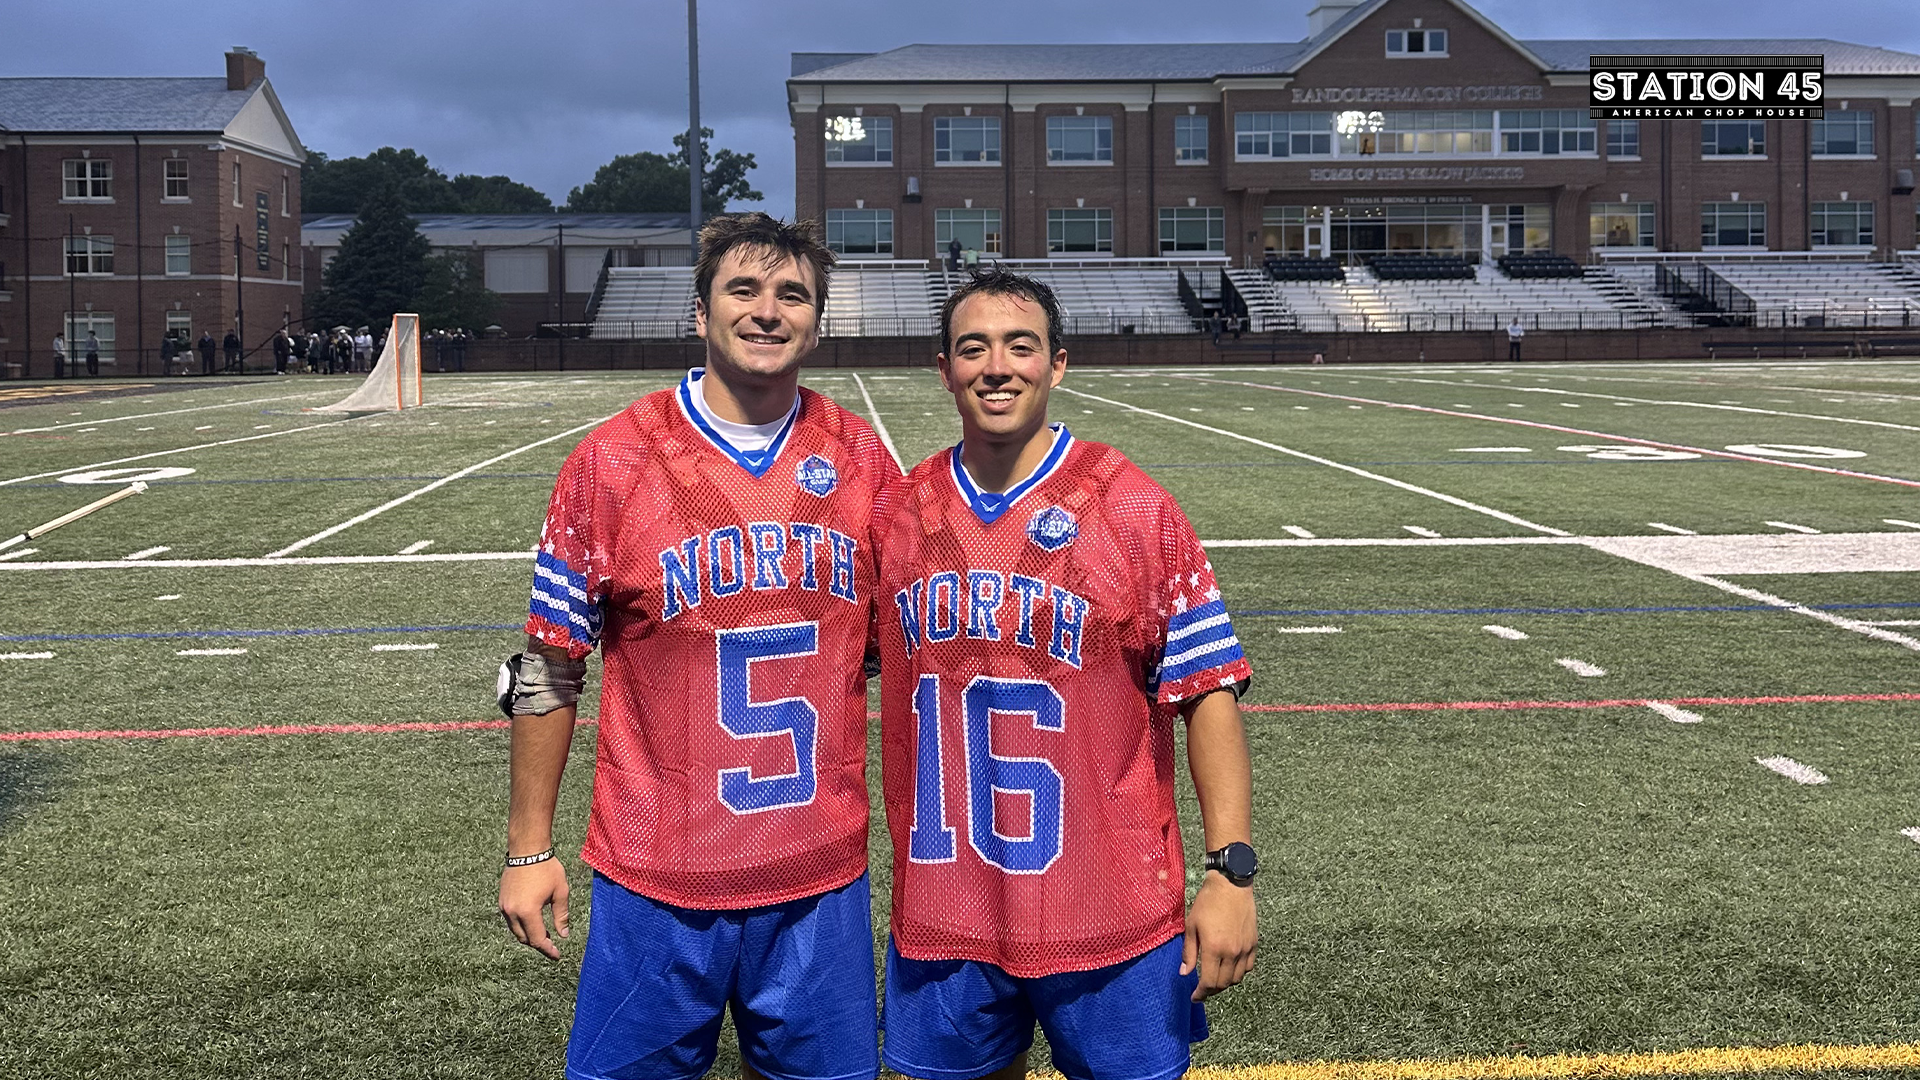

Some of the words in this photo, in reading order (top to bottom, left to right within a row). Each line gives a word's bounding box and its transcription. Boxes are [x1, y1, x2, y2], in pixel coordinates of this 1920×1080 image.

[1291, 87, 1461, 102] RANDOLPH-MACON
[1462, 86, 1543, 100] COLLEGE
[1310, 168, 1353, 181] HOME
[1355, 168, 1374, 181] OF
[1376, 167, 1405, 180] THE
[1406, 167, 1463, 180] YELLOW
[659, 521, 858, 622] NORTH
[896, 570, 1089, 669] NORTH
[715, 621, 819, 816] 5
[909, 674, 1066, 875] 16
[526, 856, 538, 864] BY
